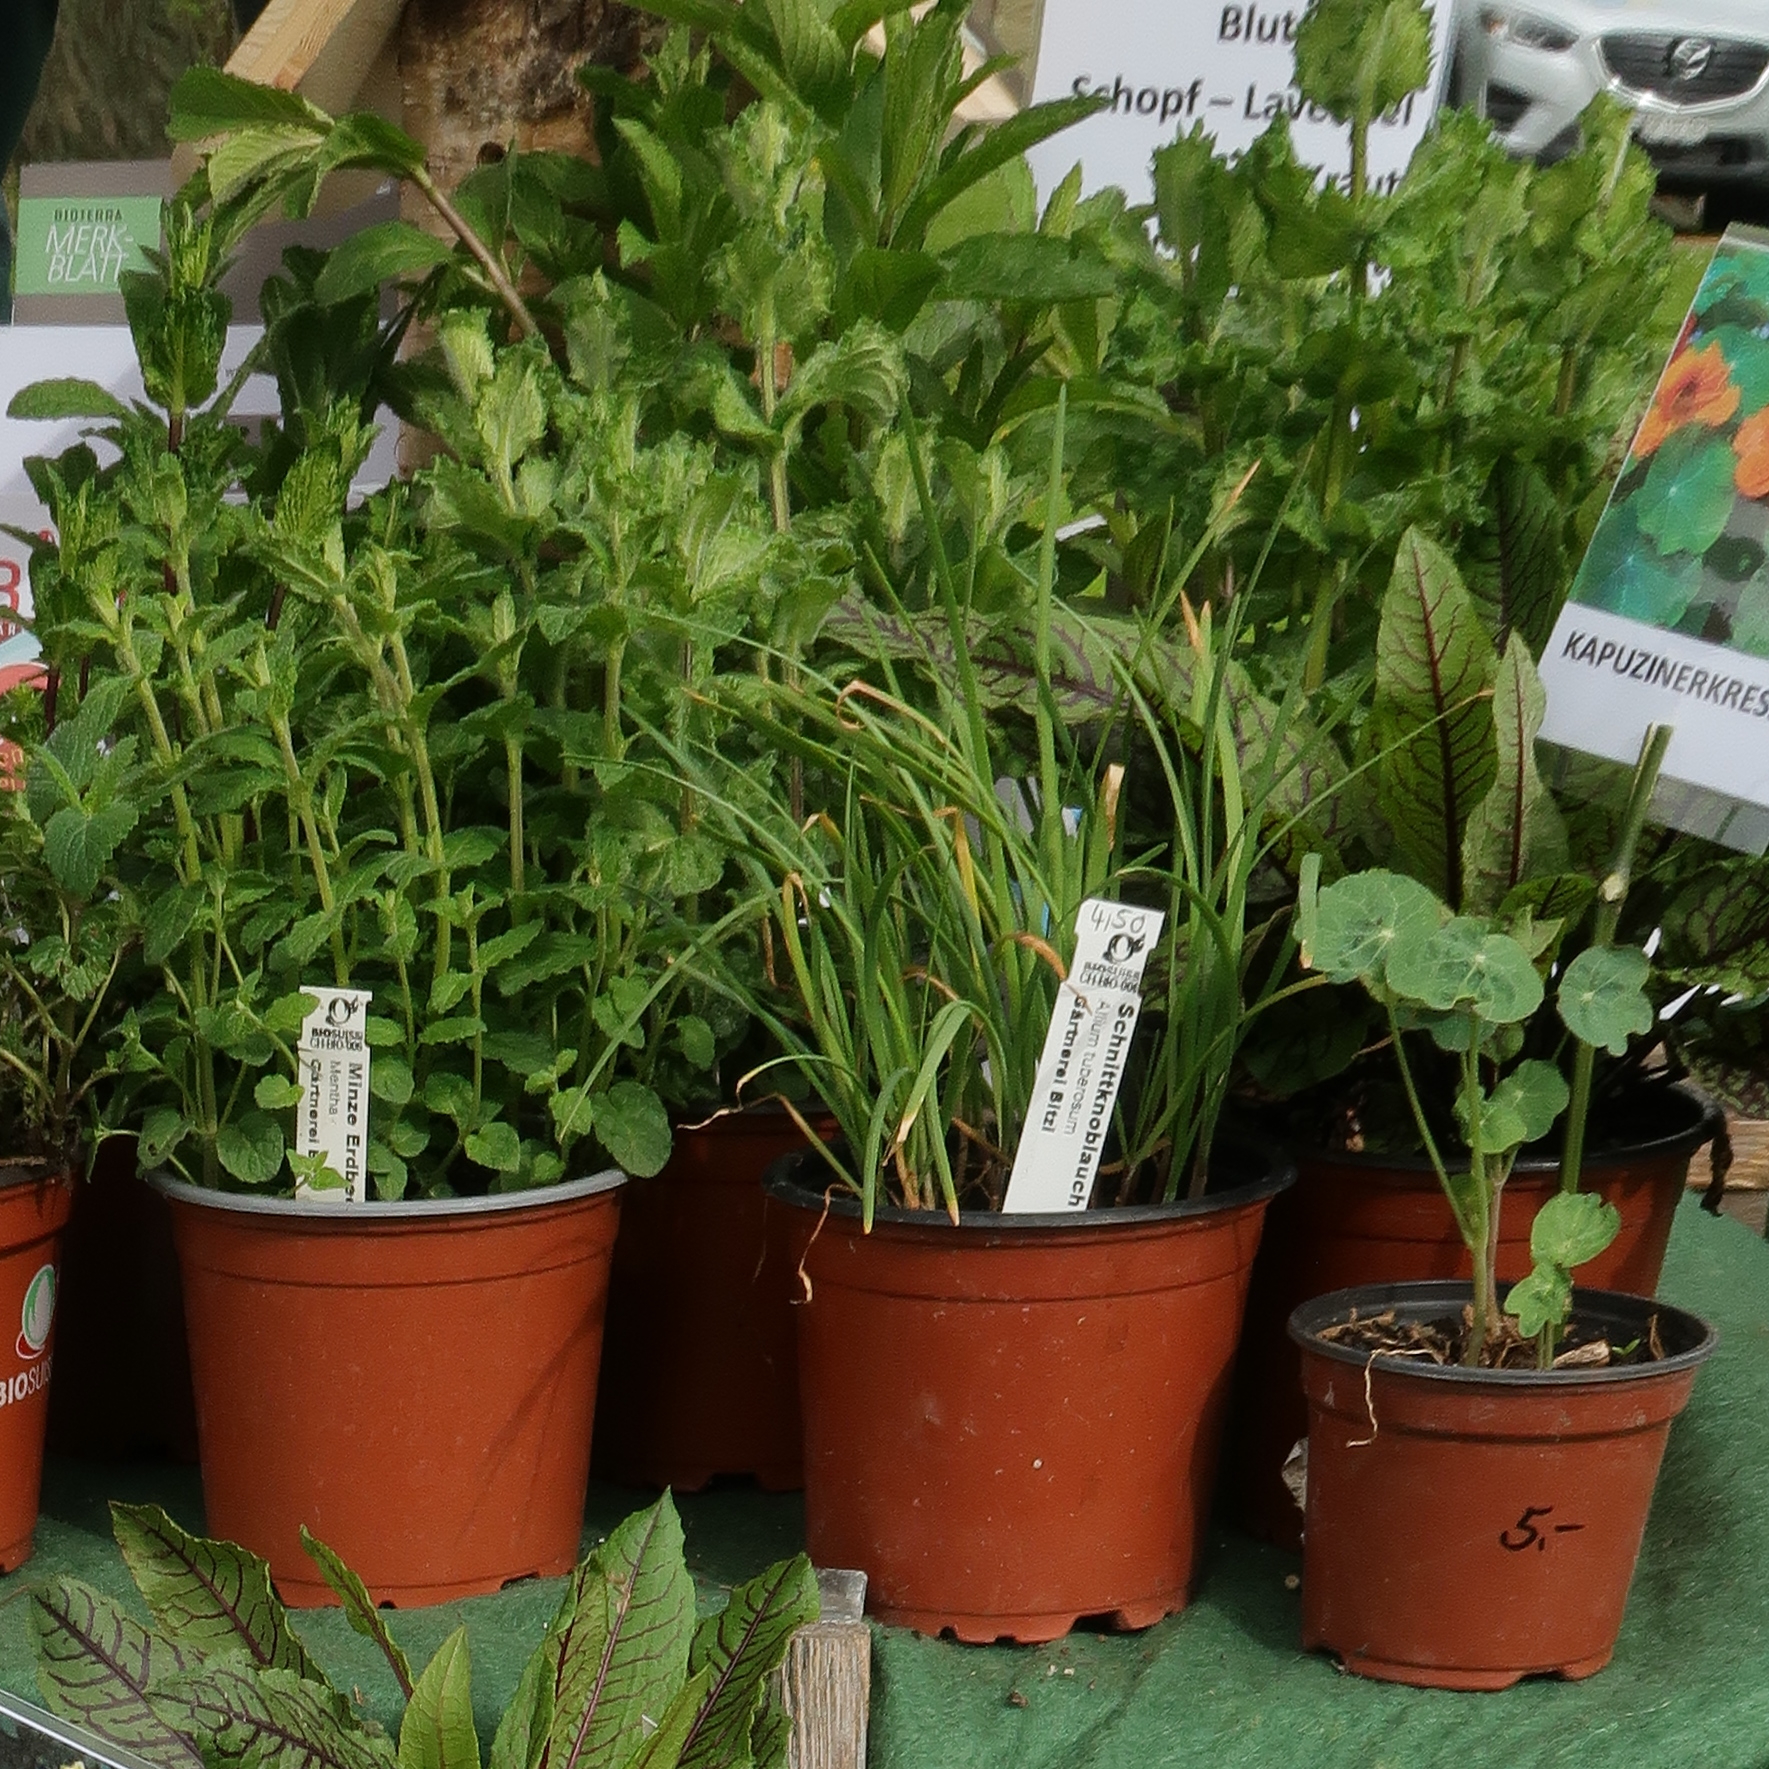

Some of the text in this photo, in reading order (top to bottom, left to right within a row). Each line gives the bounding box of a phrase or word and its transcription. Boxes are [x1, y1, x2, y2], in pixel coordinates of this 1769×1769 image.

[53, 207, 122, 222] BIOTERRA
[47, 252, 129, 284] BLATT
[1562, 629, 1769, 721] KAPUZINERKRES
[1051, 995, 1087, 1089] Gärtnerei
[1063, 999, 1112, 1136] Allium tuberosum
[307, 1058, 322, 1144] Gärtnerei
[328, 1060, 342, 1116] Mentha
[346, 1062, 363, 1126] Minze
[1067, 1002, 1135, 1208] Schnittknoblauch
